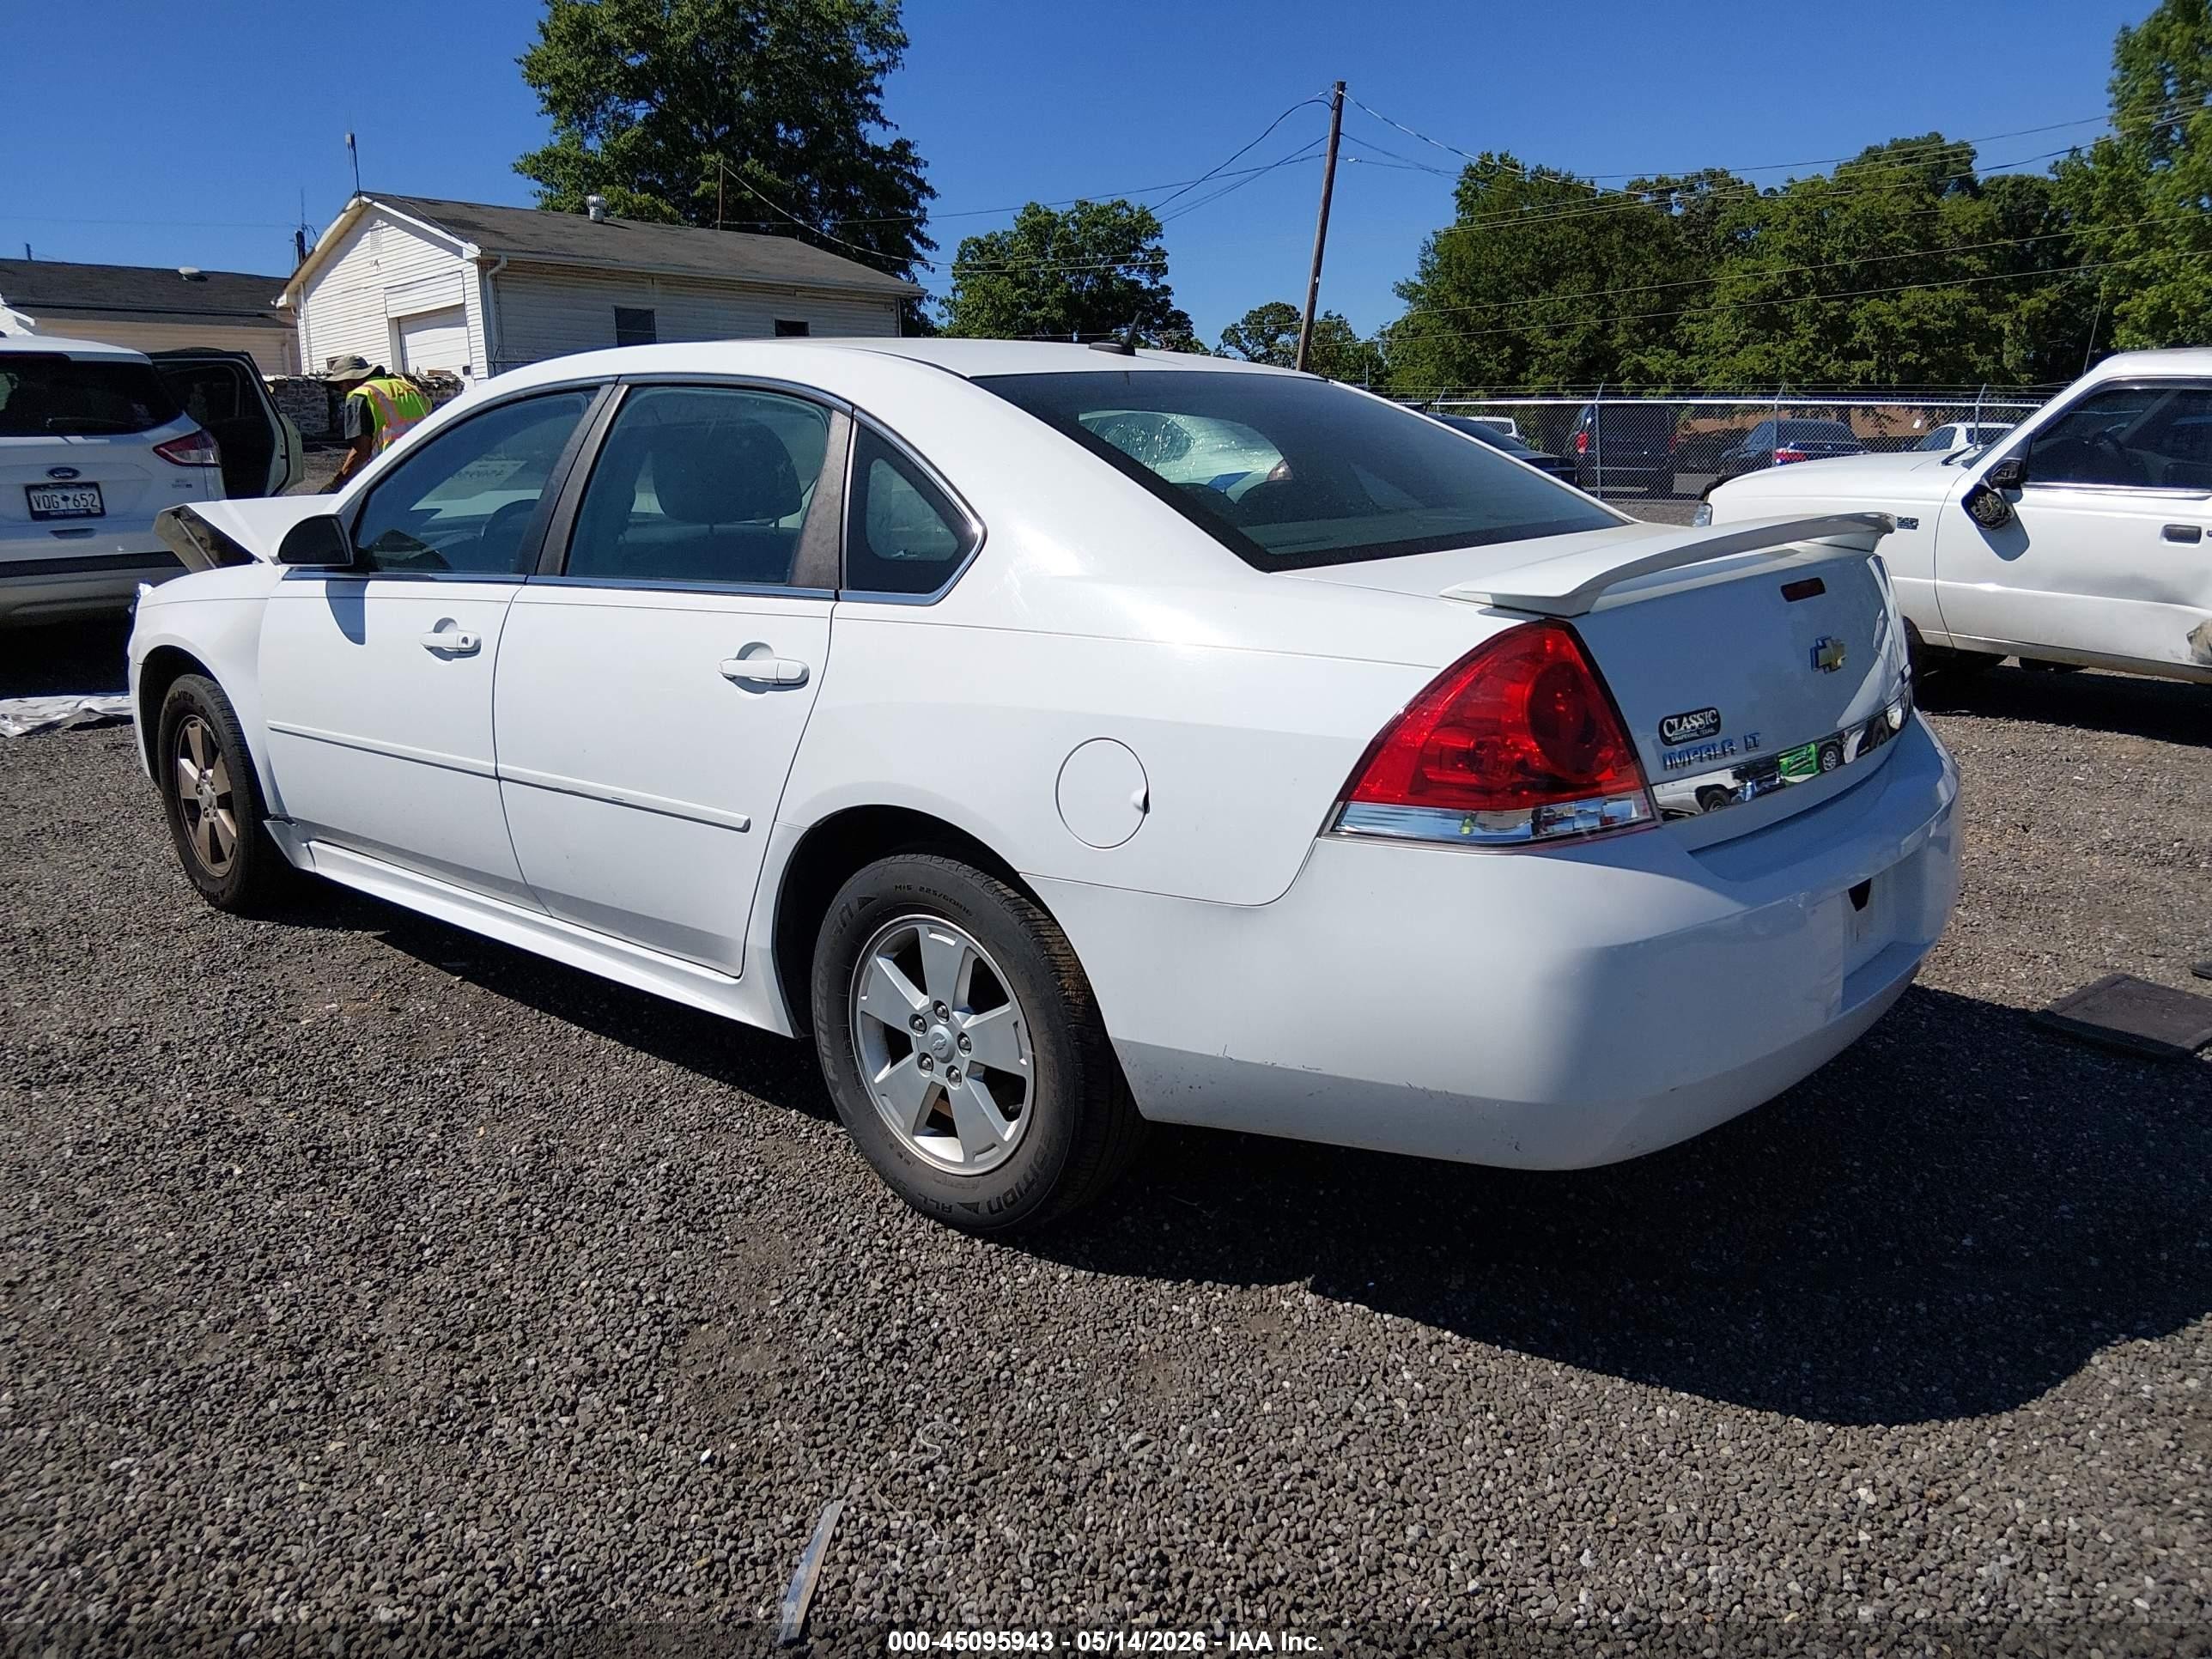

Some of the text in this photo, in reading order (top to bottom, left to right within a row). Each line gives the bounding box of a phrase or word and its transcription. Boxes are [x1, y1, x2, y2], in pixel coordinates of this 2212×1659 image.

[72, 492, 100, 509] 652
[1662, 708, 1718, 738] CLASSIC
[1662, 738, 1737, 770] IMPALA
